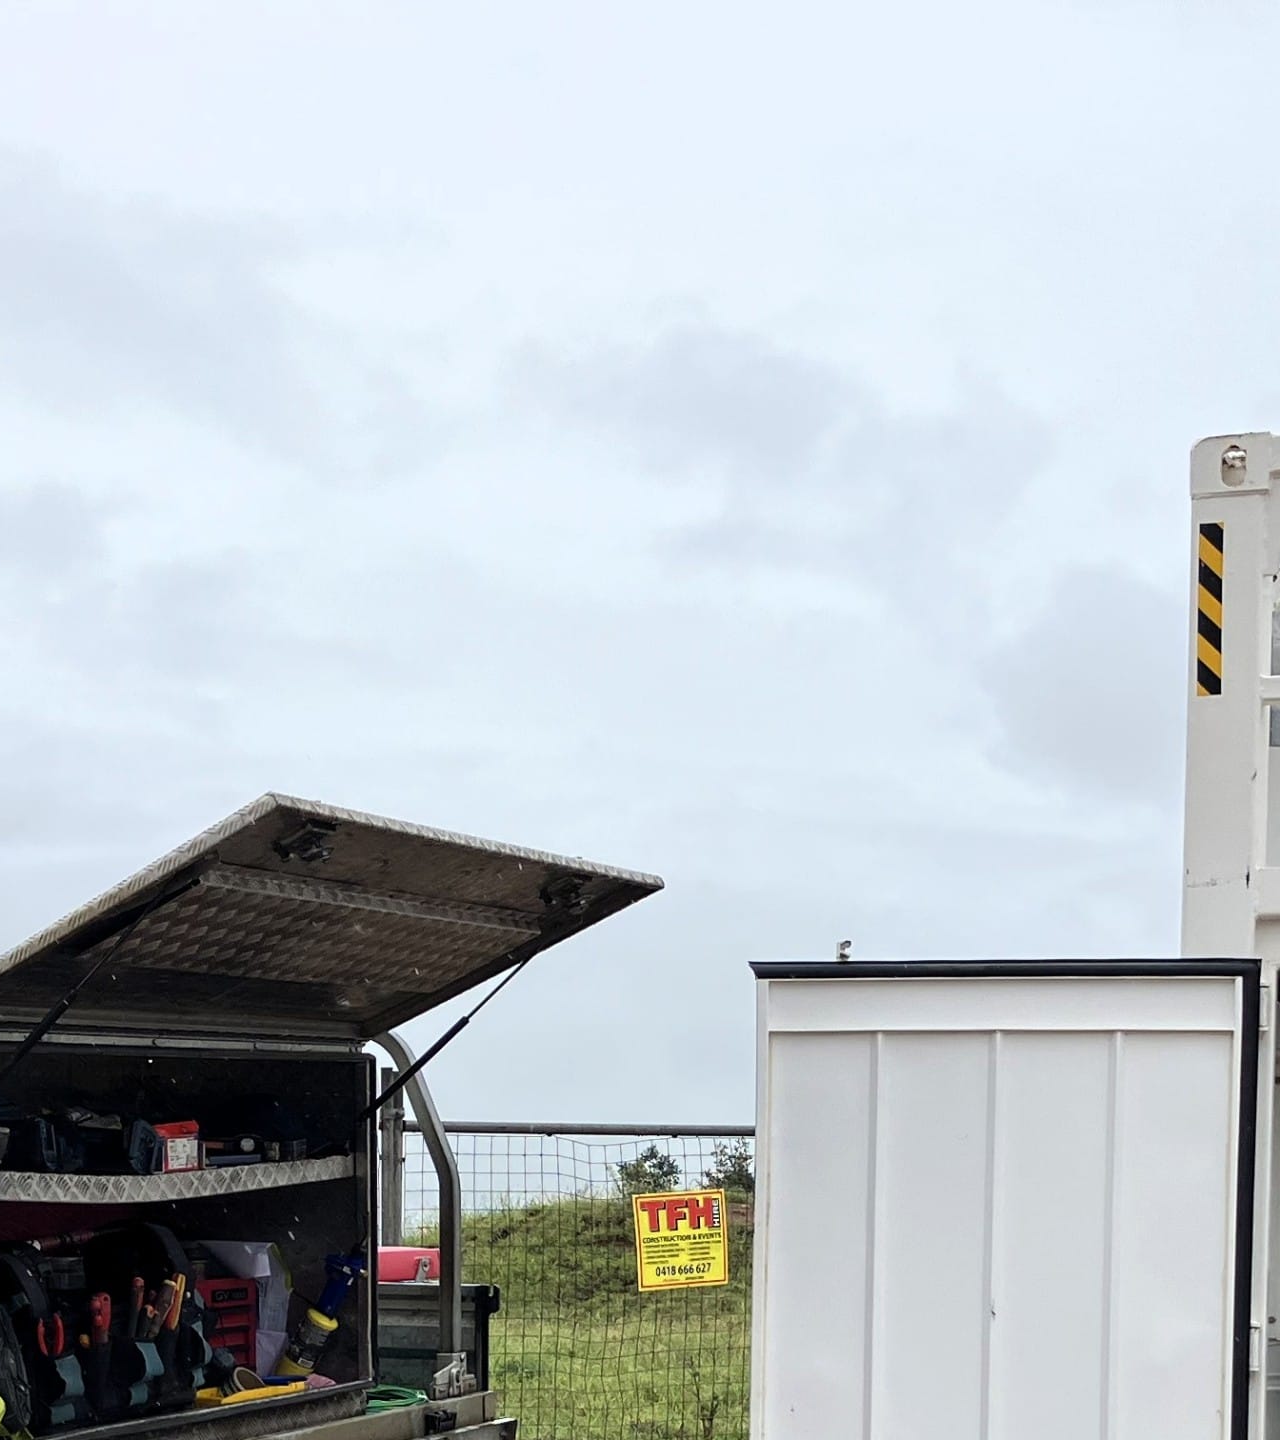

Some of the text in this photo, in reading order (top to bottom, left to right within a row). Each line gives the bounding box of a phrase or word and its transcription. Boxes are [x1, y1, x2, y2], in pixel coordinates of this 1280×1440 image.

[640, 1197, 713, 1232] TFH
[643, 1235, 691, 1244] CONSTRUCTION
[656, 1263, 711, 1276] 0418 666 627
